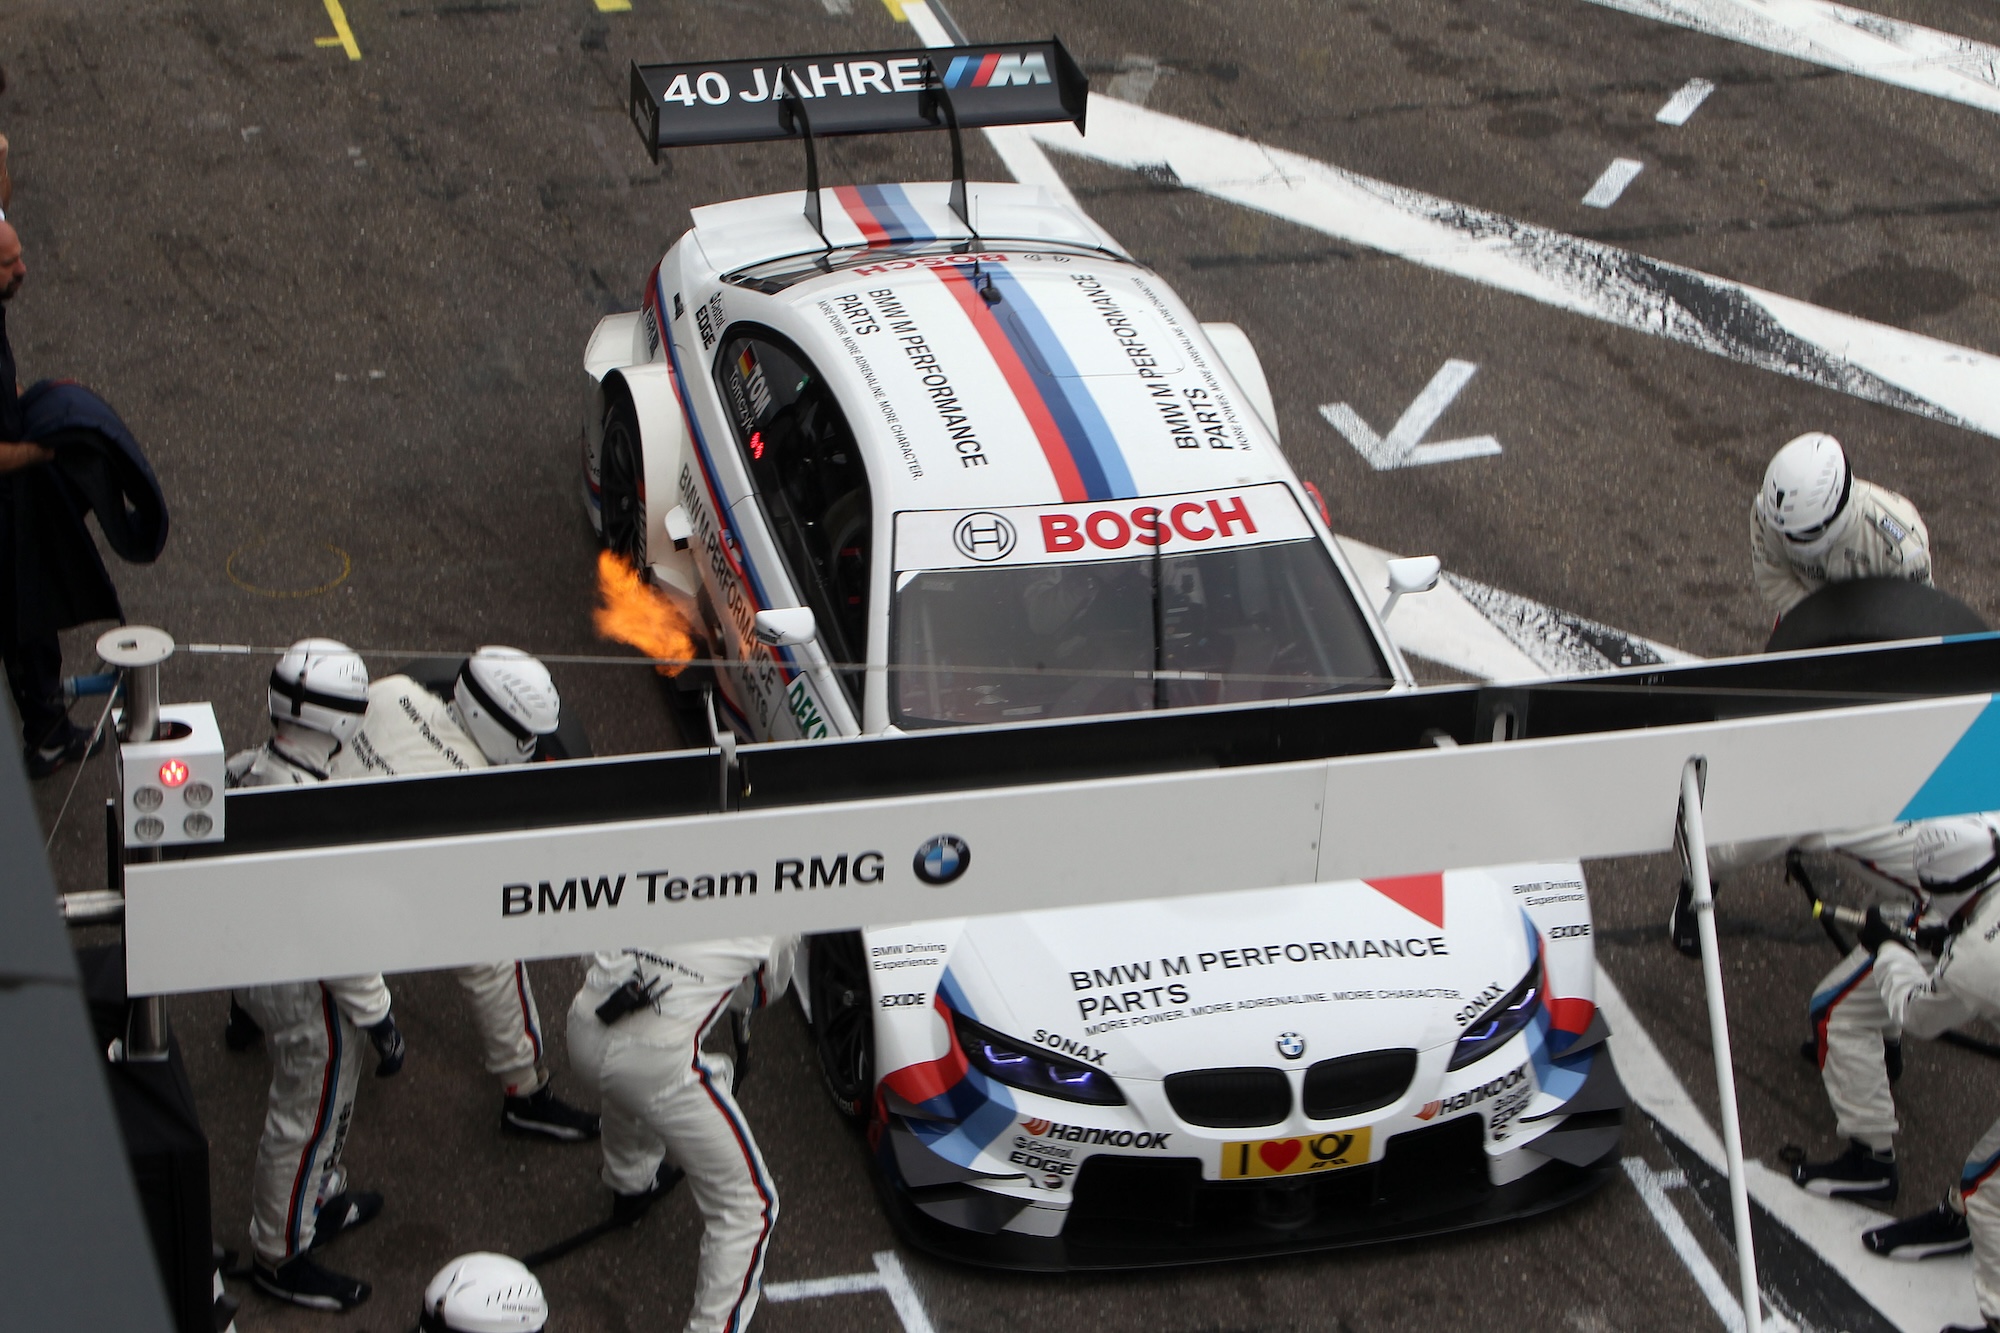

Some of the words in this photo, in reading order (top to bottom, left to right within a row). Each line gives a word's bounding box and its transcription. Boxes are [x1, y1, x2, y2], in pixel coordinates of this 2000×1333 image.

[663, 71, 731, 107] 40
[738, 57, 944, 103] JAHRE
[852, 253, 1009, 277] BOSCH
[834, 293, 881, 336] PARTS
[868, 288, 910, 319] BMW
[889, 319, 919, 334] M
[1070, 274, 1165, 379] PERFORMANCE
[695, 304, 716, 351] EDGE
[729, 364, 754, 434] Tomczyk
[746, 362, 772, 419] TOM
[841, 335, 861, 358] MORE
[878, 400, 900, 426] MORE
[890, 424, 924, 481] CHARACTER.
[899, 334, 989, 469] PERFORMANCE
[1146, 383, 1176, 398] M
[1156, 401, 1202, 450] BMW
[1183, 387, 1235, 450] PARTS
[679, 462, 702, 524] BMW
[699, 511, 710, 544] M
[1039, 496, 1258, 553] BOSCH
[501, 873, 626, 918] BMW
[636, 869, 758, 906] Team
[773, 850, 886, 893] RMG
[872, 944, 904, 957] BMW
[905, 942, 947, 954] Driving
[873, 957, 939, 971] Experience
[1068, 960, 1153, 992] BMW
[1162, 955, 1191, 978] M
[1199, 936, 1450, 972] PERFORMANCE
[879, 992, 926, 1008] EXIDE
[1078, 983, 1190, 1021] PARTS
[1084, 1017, 1129, 1037] MORE
[1131, 1009, 1189, 1027] POWER.
[1191, 1000, 1233, 1017] MORE
[1236, 991, 1330, 1011] ADRENALINE.
[1333, 989, 1374, 1003] MORE
[1376, 987, 1466, 1002] CHARACTER.
[1454, 982, 1505, 1027] SONAX
[1032, 1028, 1109, 1067] SONAX
[1009, 1150, 1078, 1176] EDGE
[1027, 1140, 1074, 1159] Castrol
[1240, 1143, 1250, 1176] I
